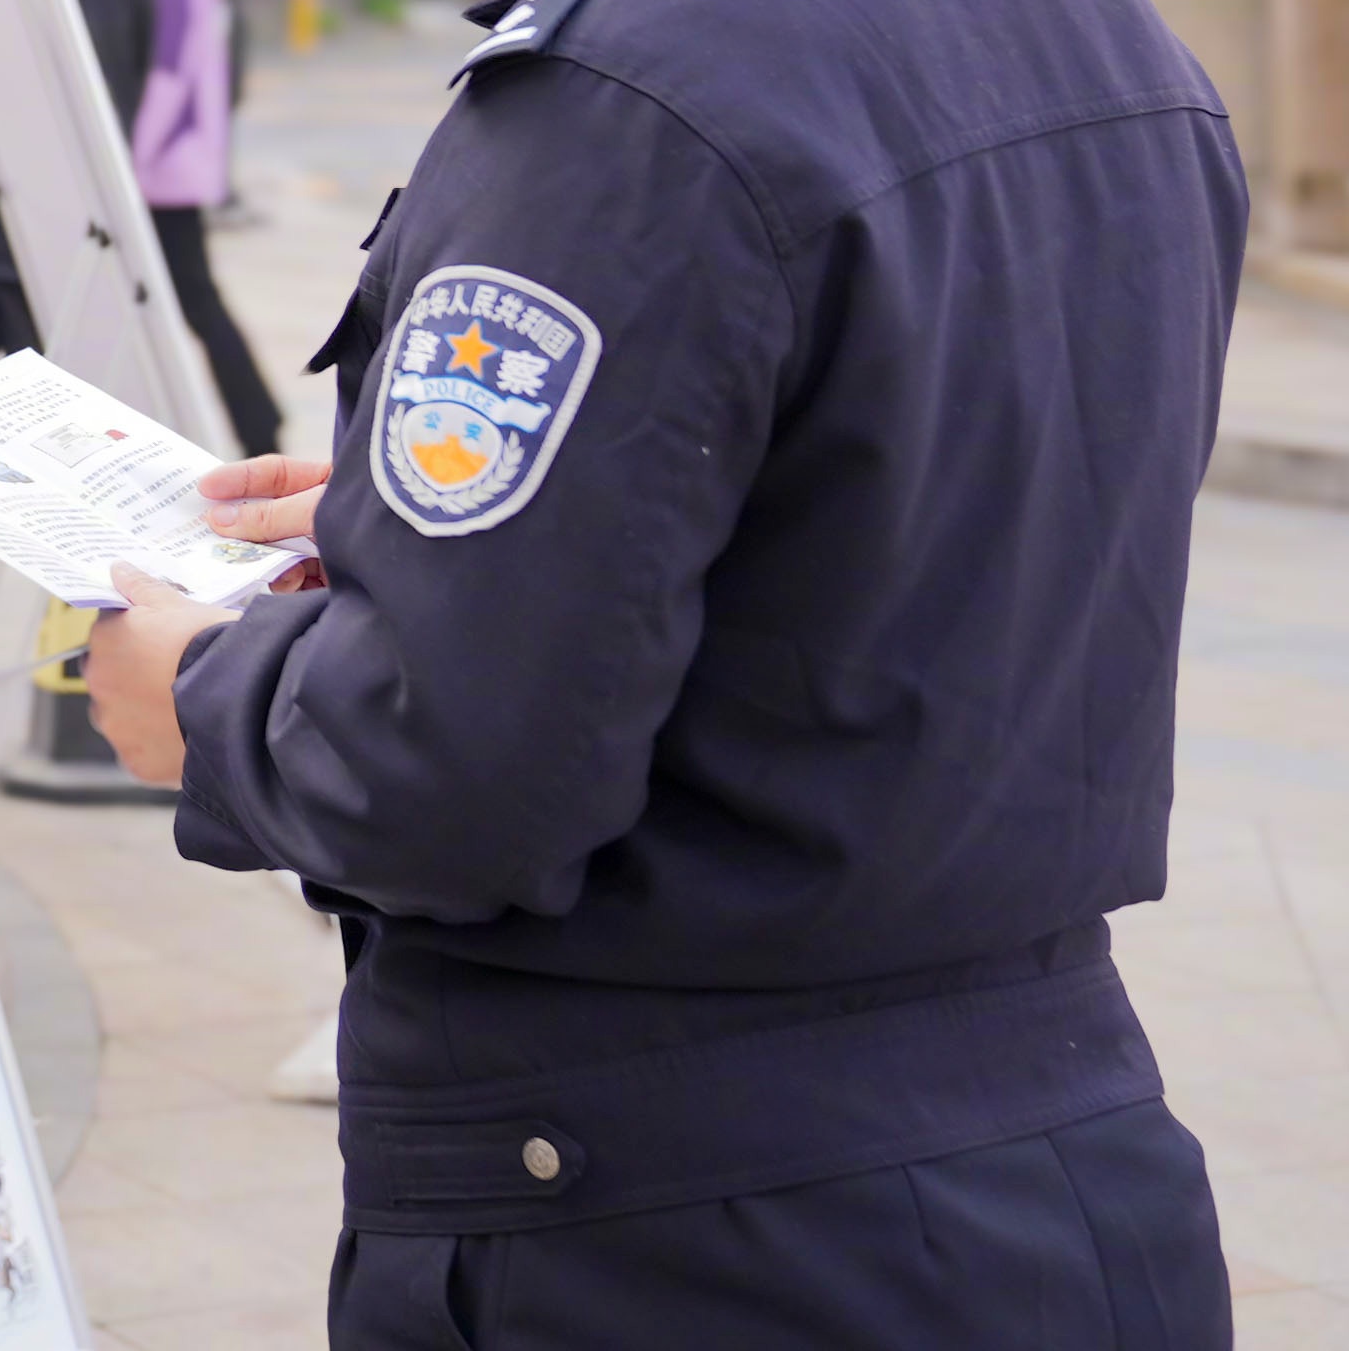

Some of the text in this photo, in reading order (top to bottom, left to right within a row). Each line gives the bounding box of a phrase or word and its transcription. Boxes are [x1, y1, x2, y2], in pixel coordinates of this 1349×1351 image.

[410, 283, 577, 361] 中华人民共和国
[402, 329, 550, 398] 警 察
[423, 379, 496, 415] POLICE
